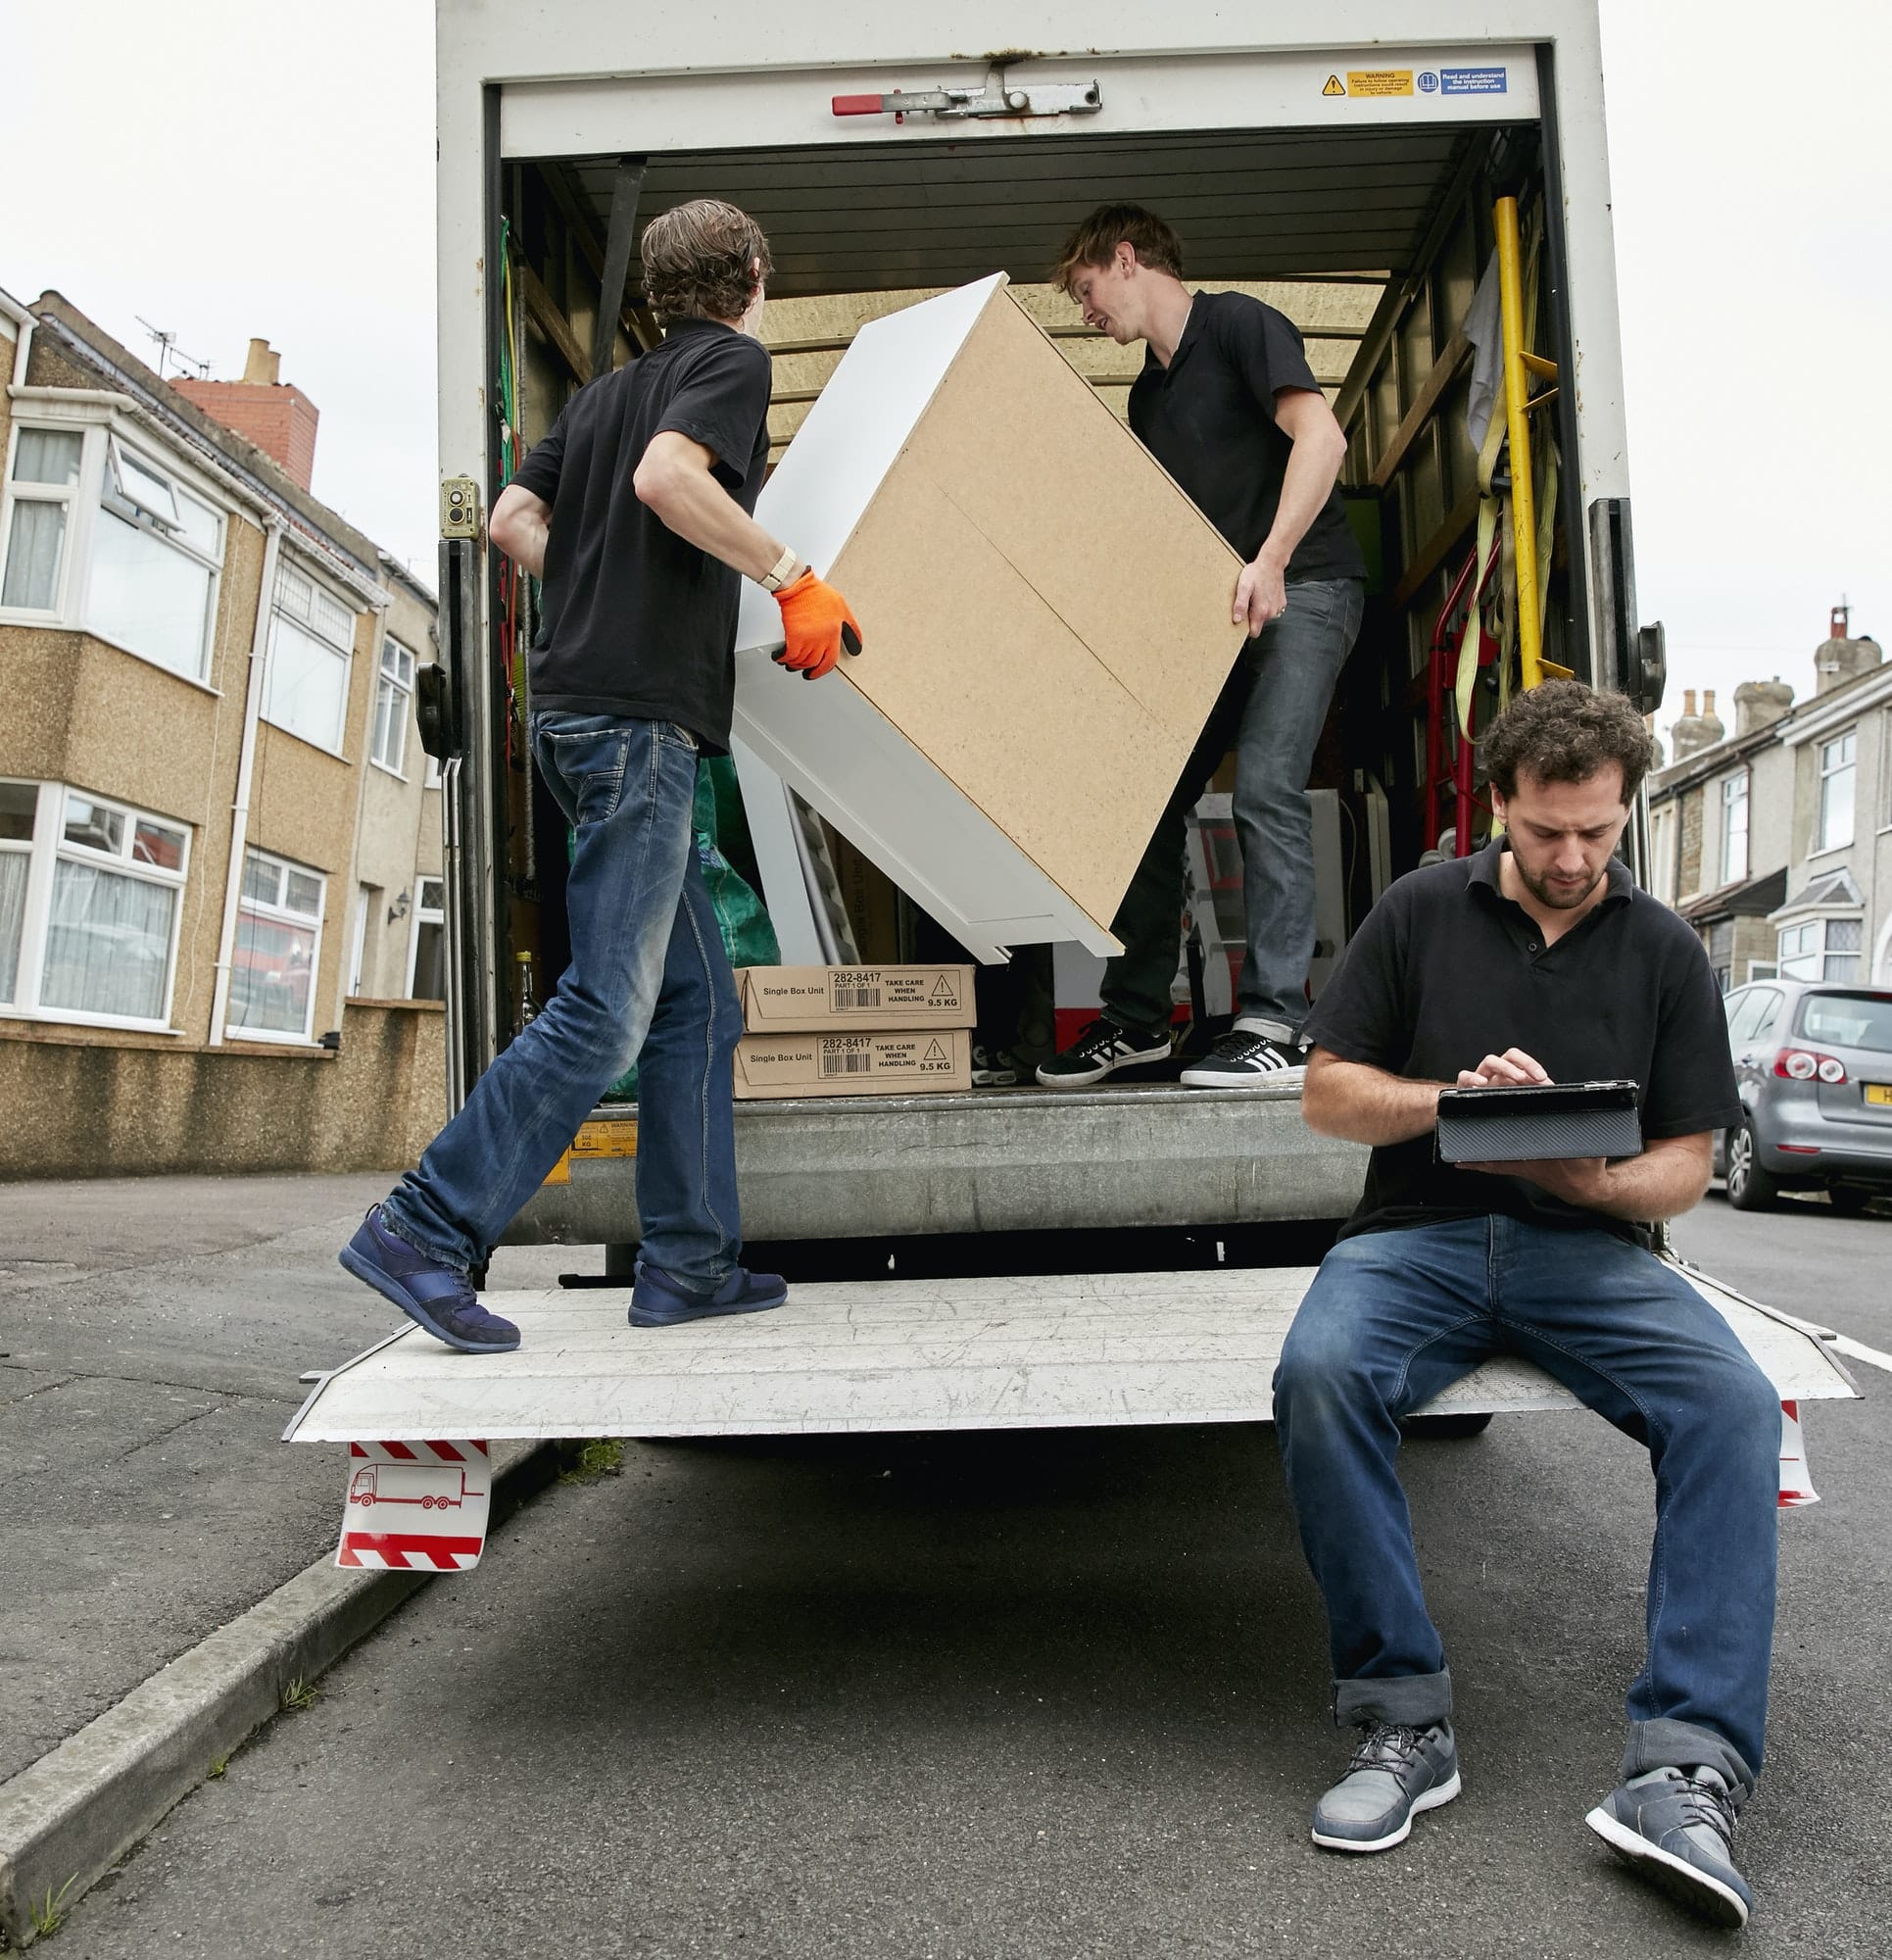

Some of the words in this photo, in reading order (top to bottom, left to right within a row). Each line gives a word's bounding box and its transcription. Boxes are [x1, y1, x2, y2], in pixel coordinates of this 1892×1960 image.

[834, 973, 881, 983] 282-8417
[763, 987, 788, 996] Single
[823, 1038, 872, 1049] 282-8417
